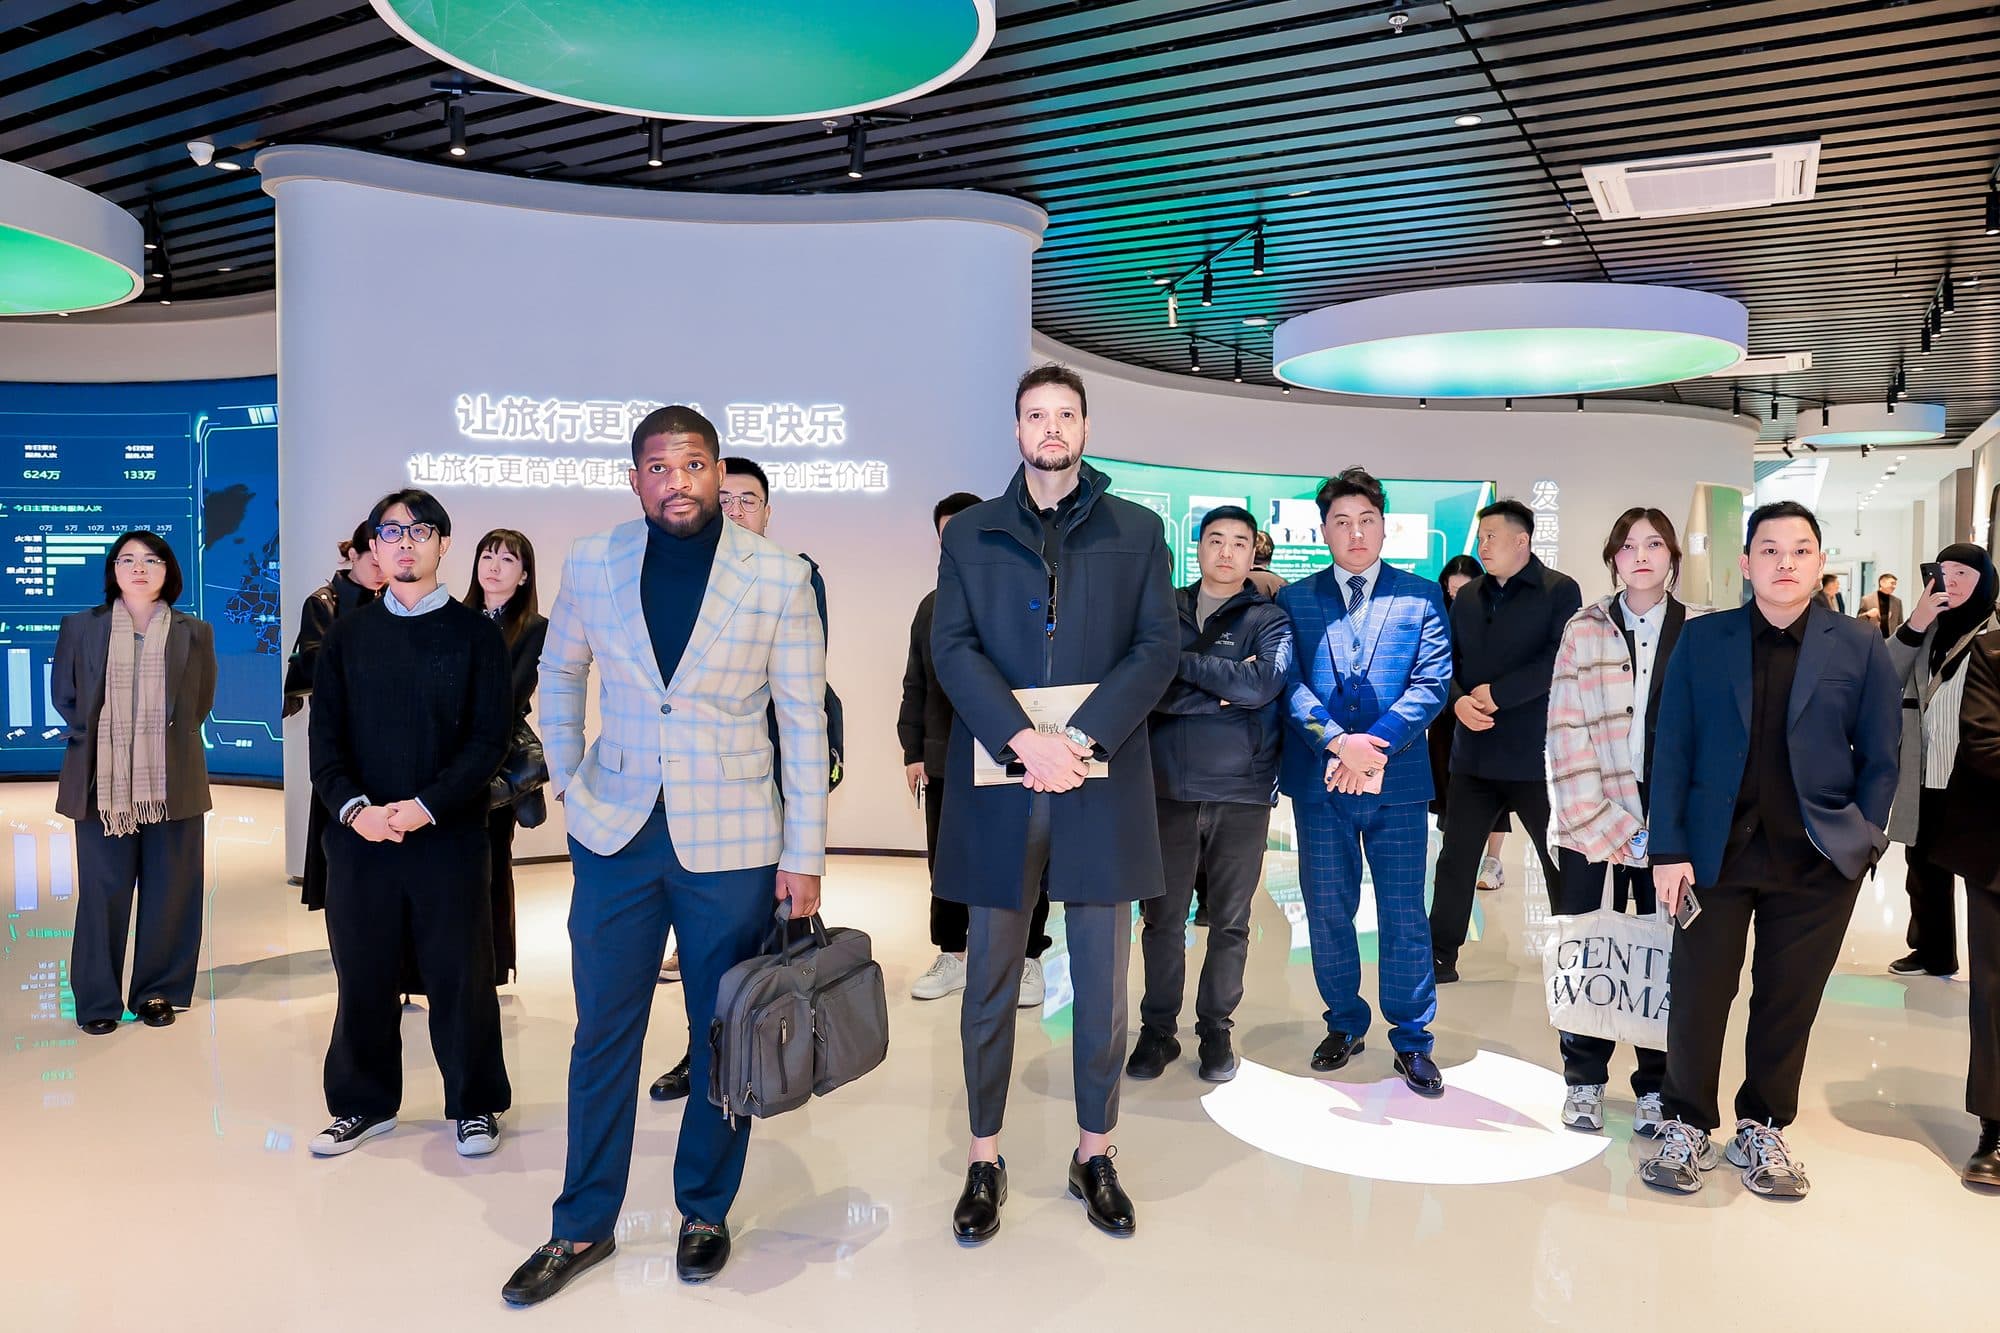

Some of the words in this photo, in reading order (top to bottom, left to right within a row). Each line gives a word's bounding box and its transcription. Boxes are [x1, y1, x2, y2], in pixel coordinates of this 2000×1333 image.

[23, 470, 61, 480] 624万
[123, 470, 156, 480] 133万
[1558, 937, 1673, 984] GENT
